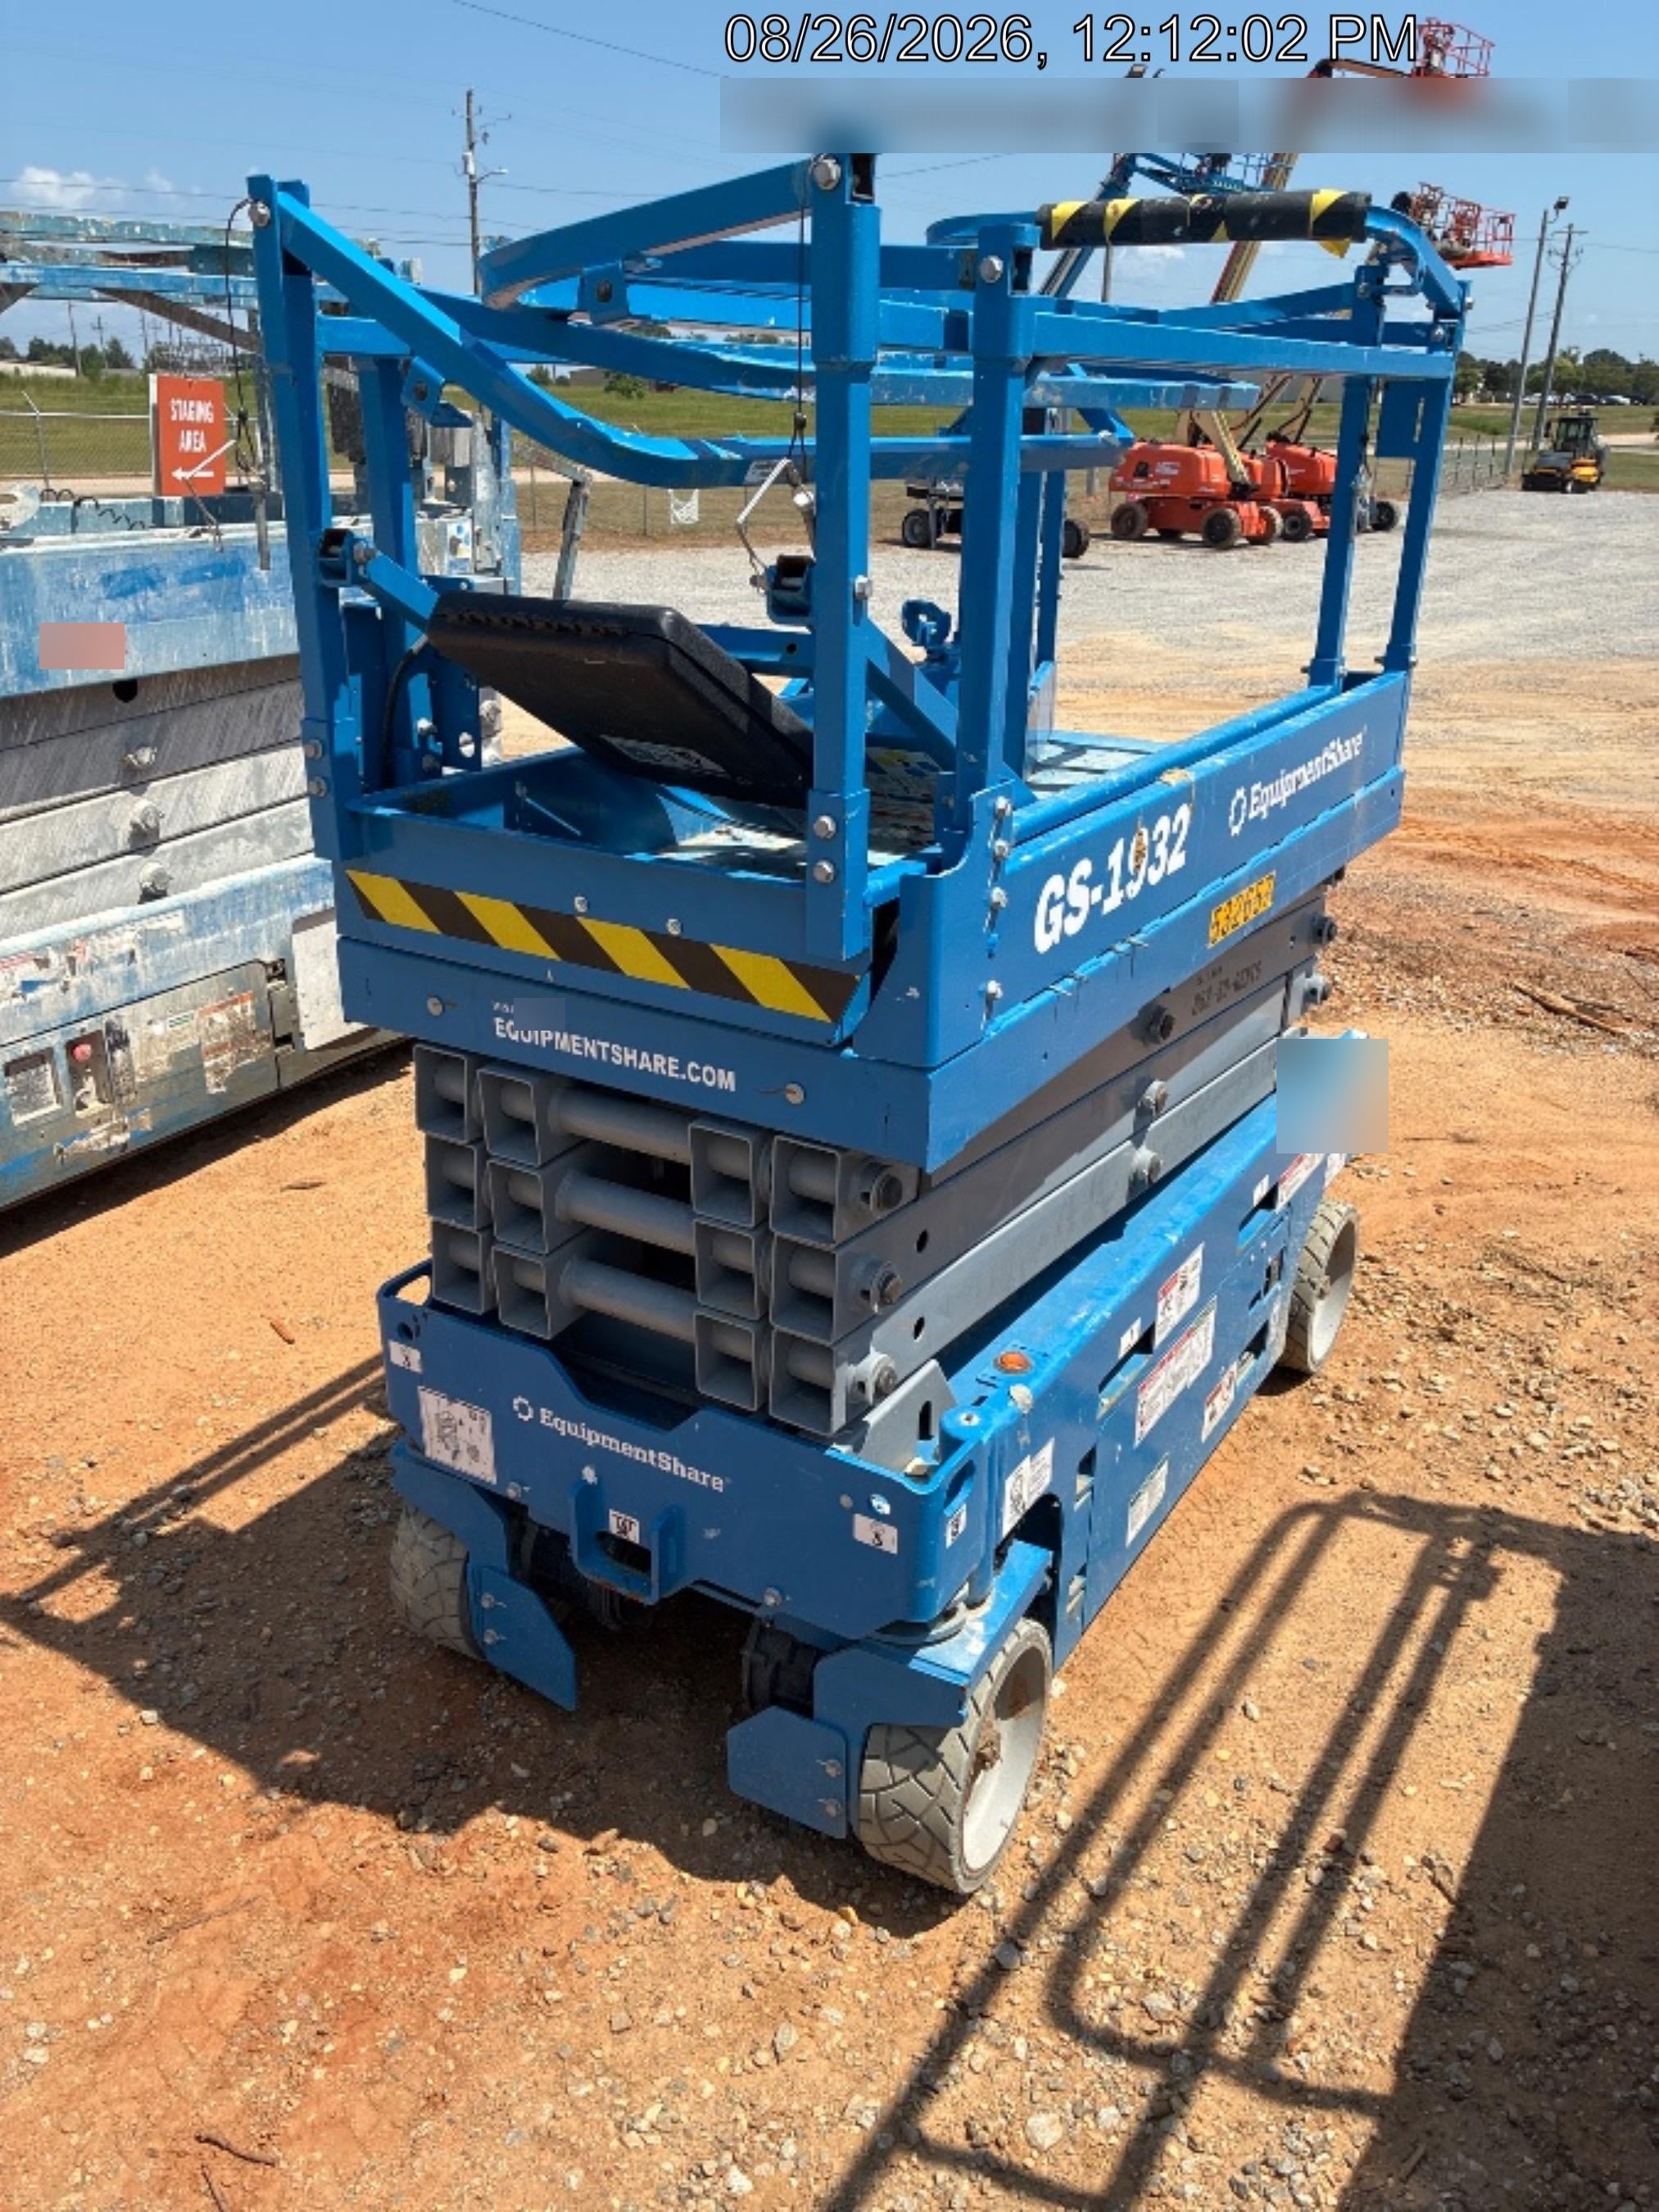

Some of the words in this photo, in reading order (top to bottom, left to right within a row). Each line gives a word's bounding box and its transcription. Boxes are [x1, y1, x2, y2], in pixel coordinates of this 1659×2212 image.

[170, 398, 215, 424] STAGING
[179, 429, 207, 453] AREA
[1249, 732, 1362, 820] EquipmentShare
[1034, 803, 1191, 954] GS-1932
[540, 1407, 723, 1493] EquipmentShare
